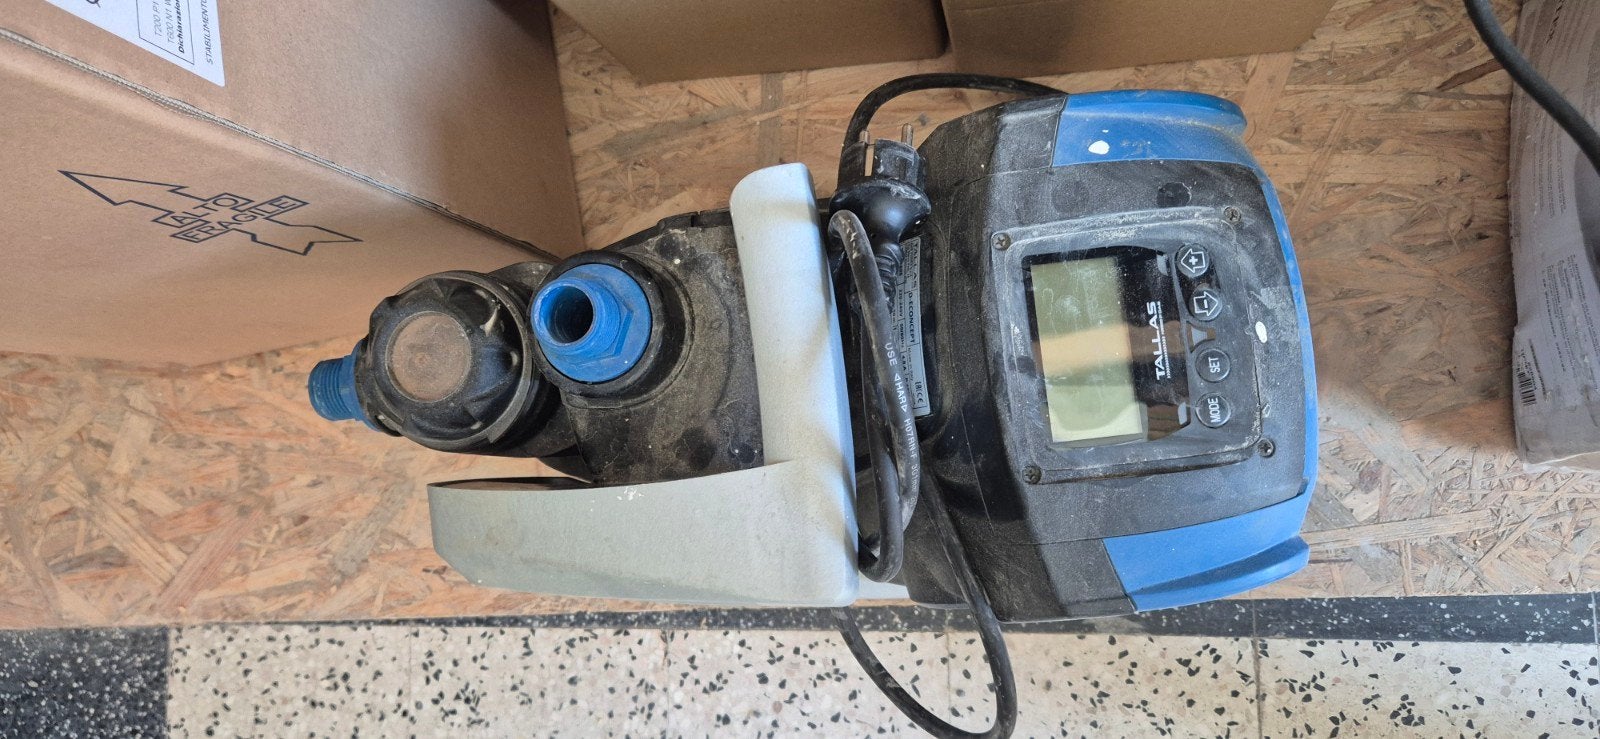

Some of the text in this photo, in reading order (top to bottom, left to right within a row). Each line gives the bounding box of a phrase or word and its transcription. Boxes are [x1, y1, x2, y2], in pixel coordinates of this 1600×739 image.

[170, 197, 238, 225] ALTO
[182, 199, 296, 240] FRAGILE
[884, 342, 898, 366] USE
[1146, 301, 1166, 380] TALLAS
[1208, 357, 1220, 374] SET
[1207, 397, 1221, 423] MODE
